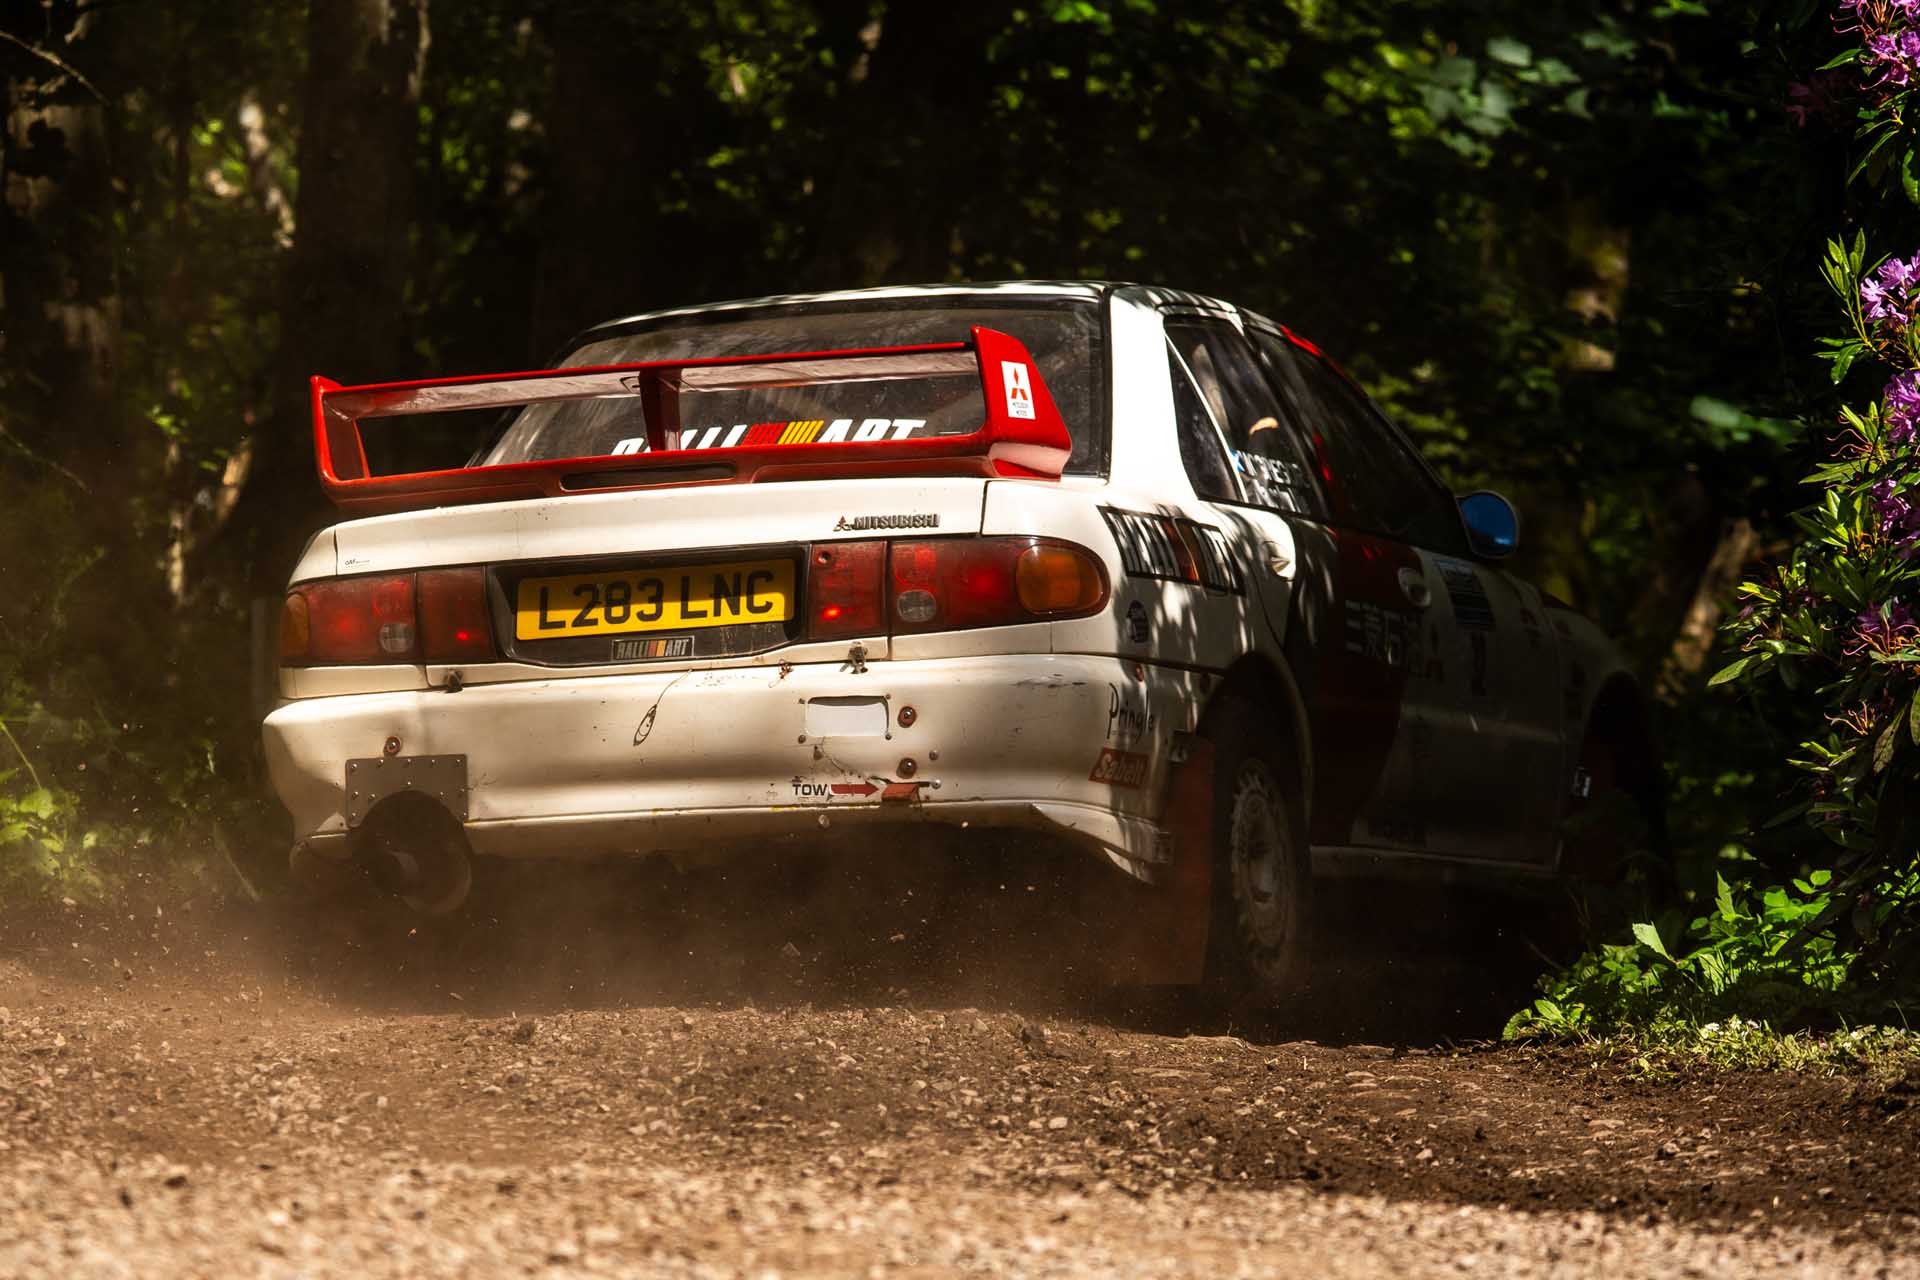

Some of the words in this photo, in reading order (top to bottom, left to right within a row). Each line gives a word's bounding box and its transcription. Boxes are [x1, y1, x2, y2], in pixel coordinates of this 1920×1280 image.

[853, 514, 940, 530] MITSUBISHI
[538, 577, 664, 631] L283
[680, 570, 774, 620] LNC
[616, 640, 649, 659] RALLI
[665, 639, 689, 657] ART
[792, 783, 828, 796] TOW
